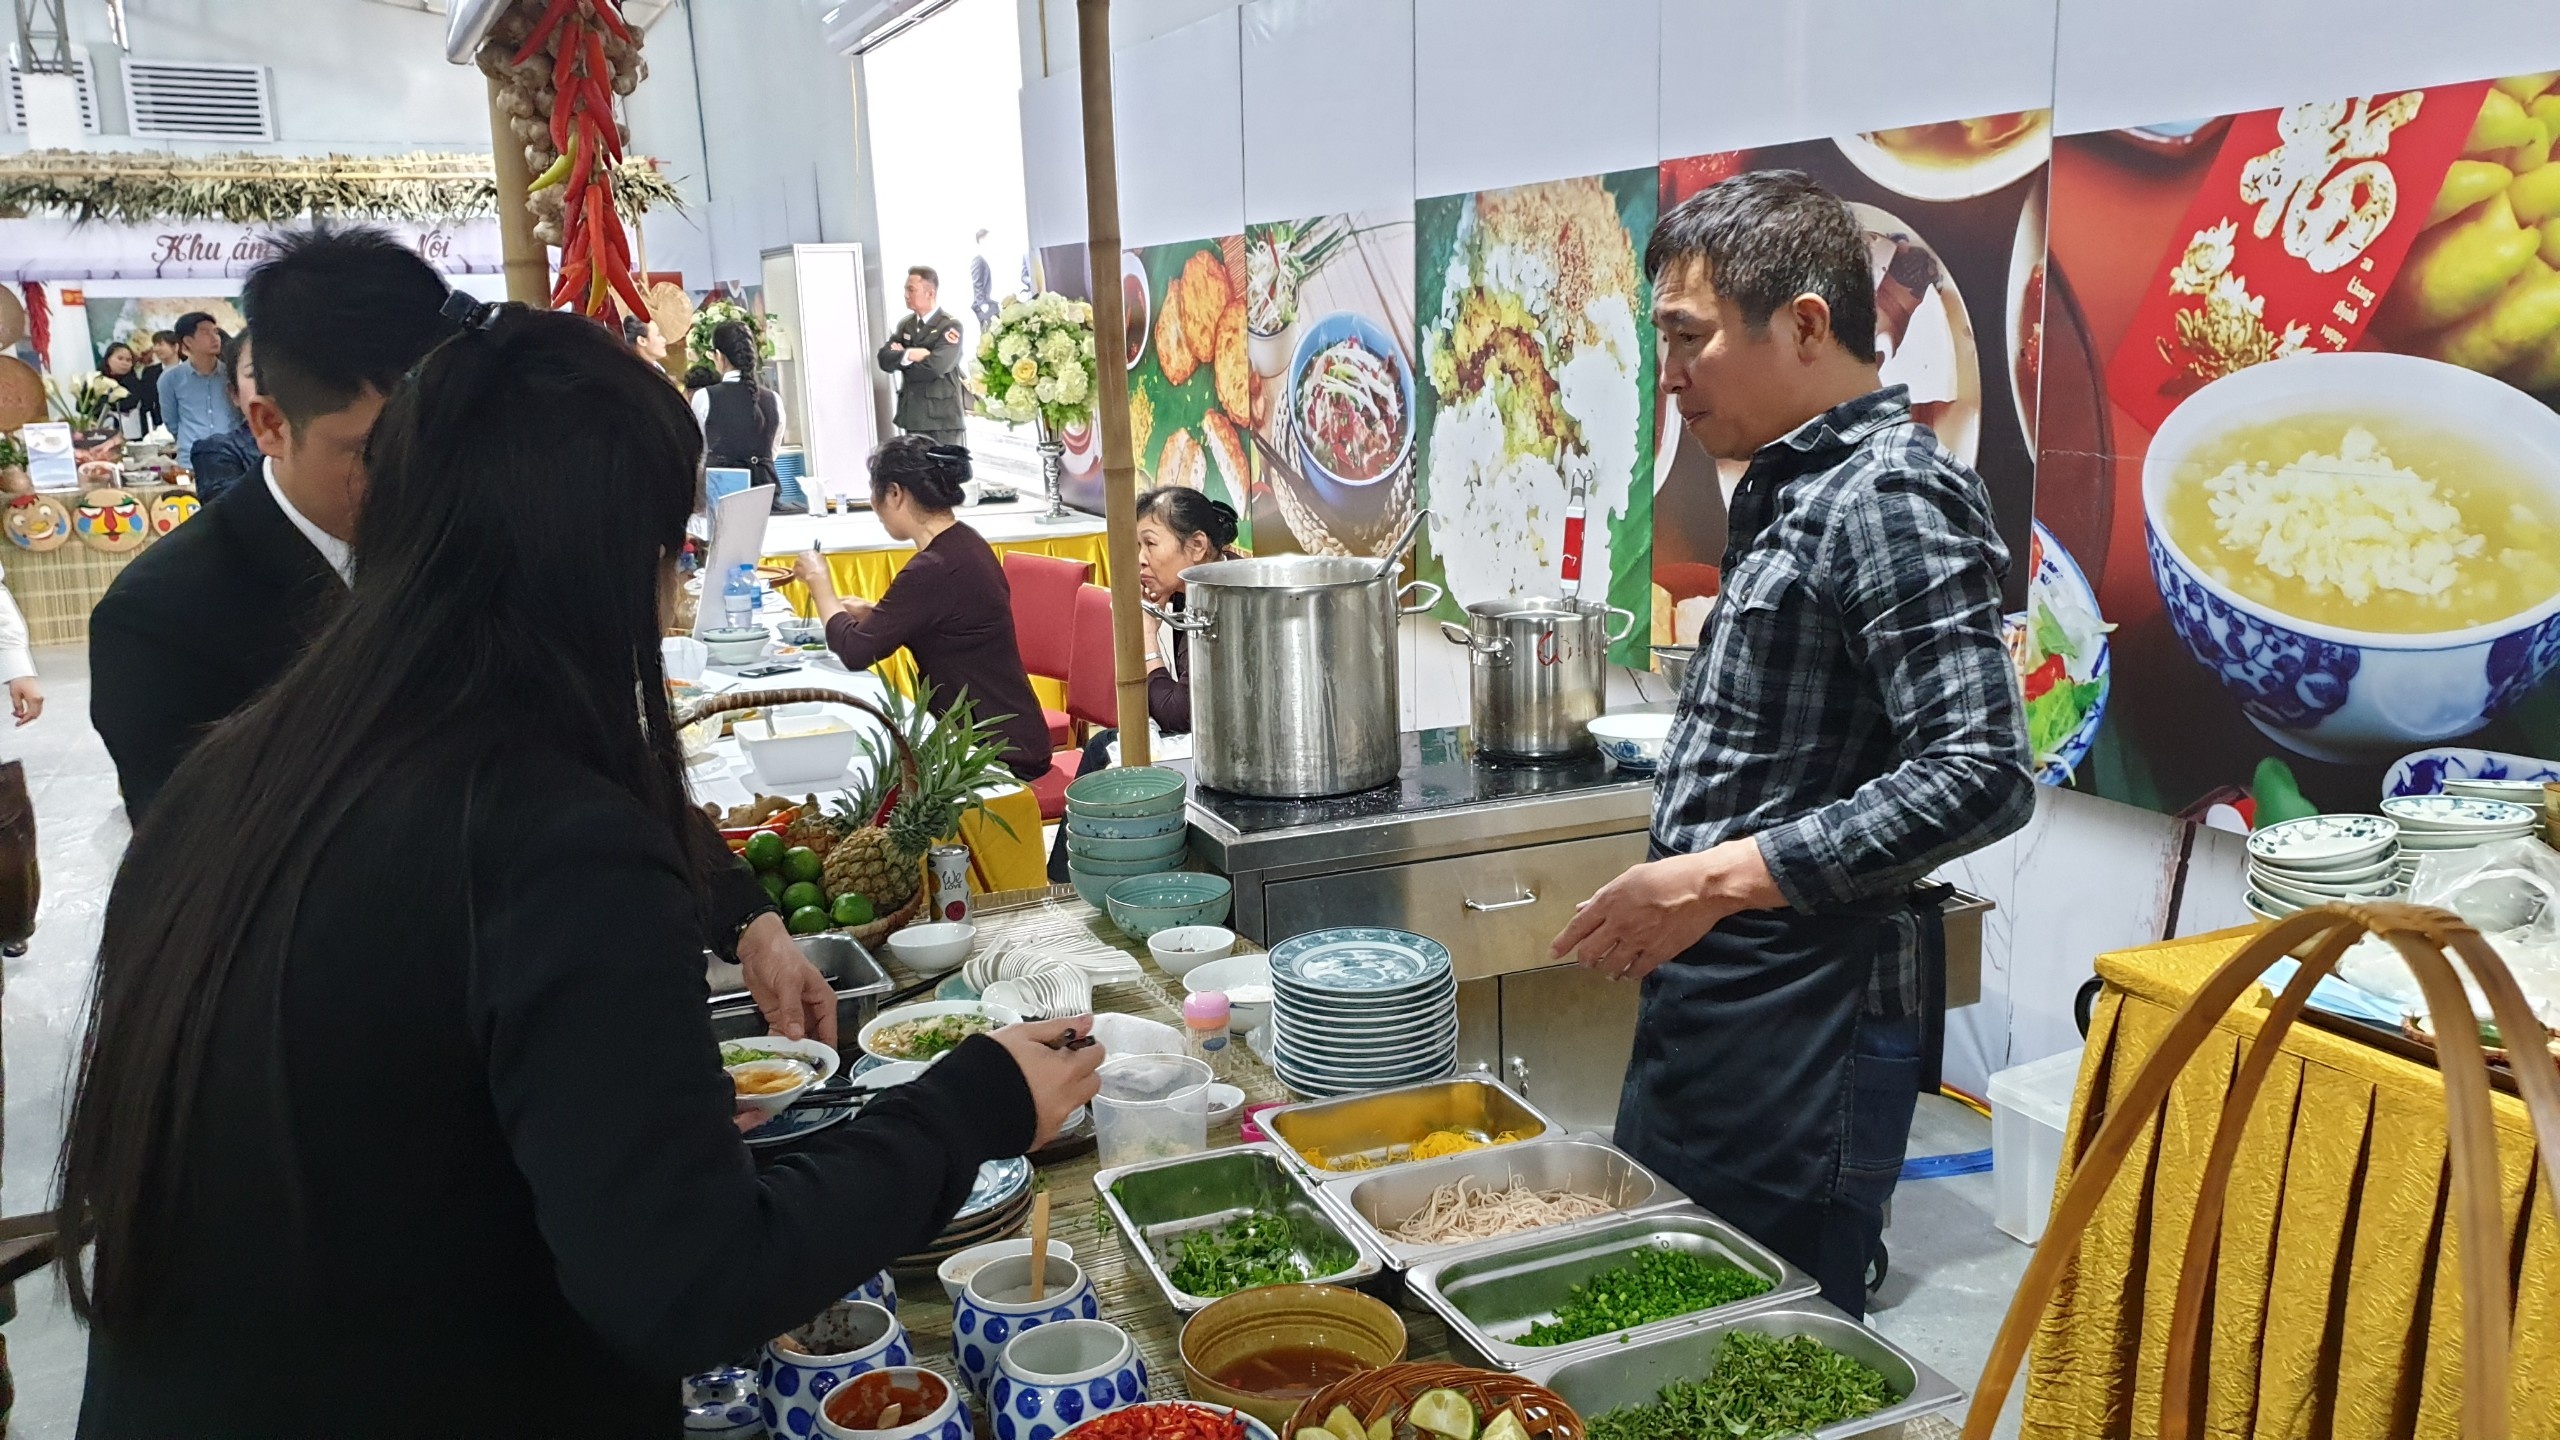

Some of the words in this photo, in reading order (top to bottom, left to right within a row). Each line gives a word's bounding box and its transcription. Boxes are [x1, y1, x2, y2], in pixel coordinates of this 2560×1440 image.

[151, 232, 221, 263] Khu
[416, 230, 452, 262] Nội
[942, 870, 962, 884] We
[944, 882, 962, 890] LOVE
